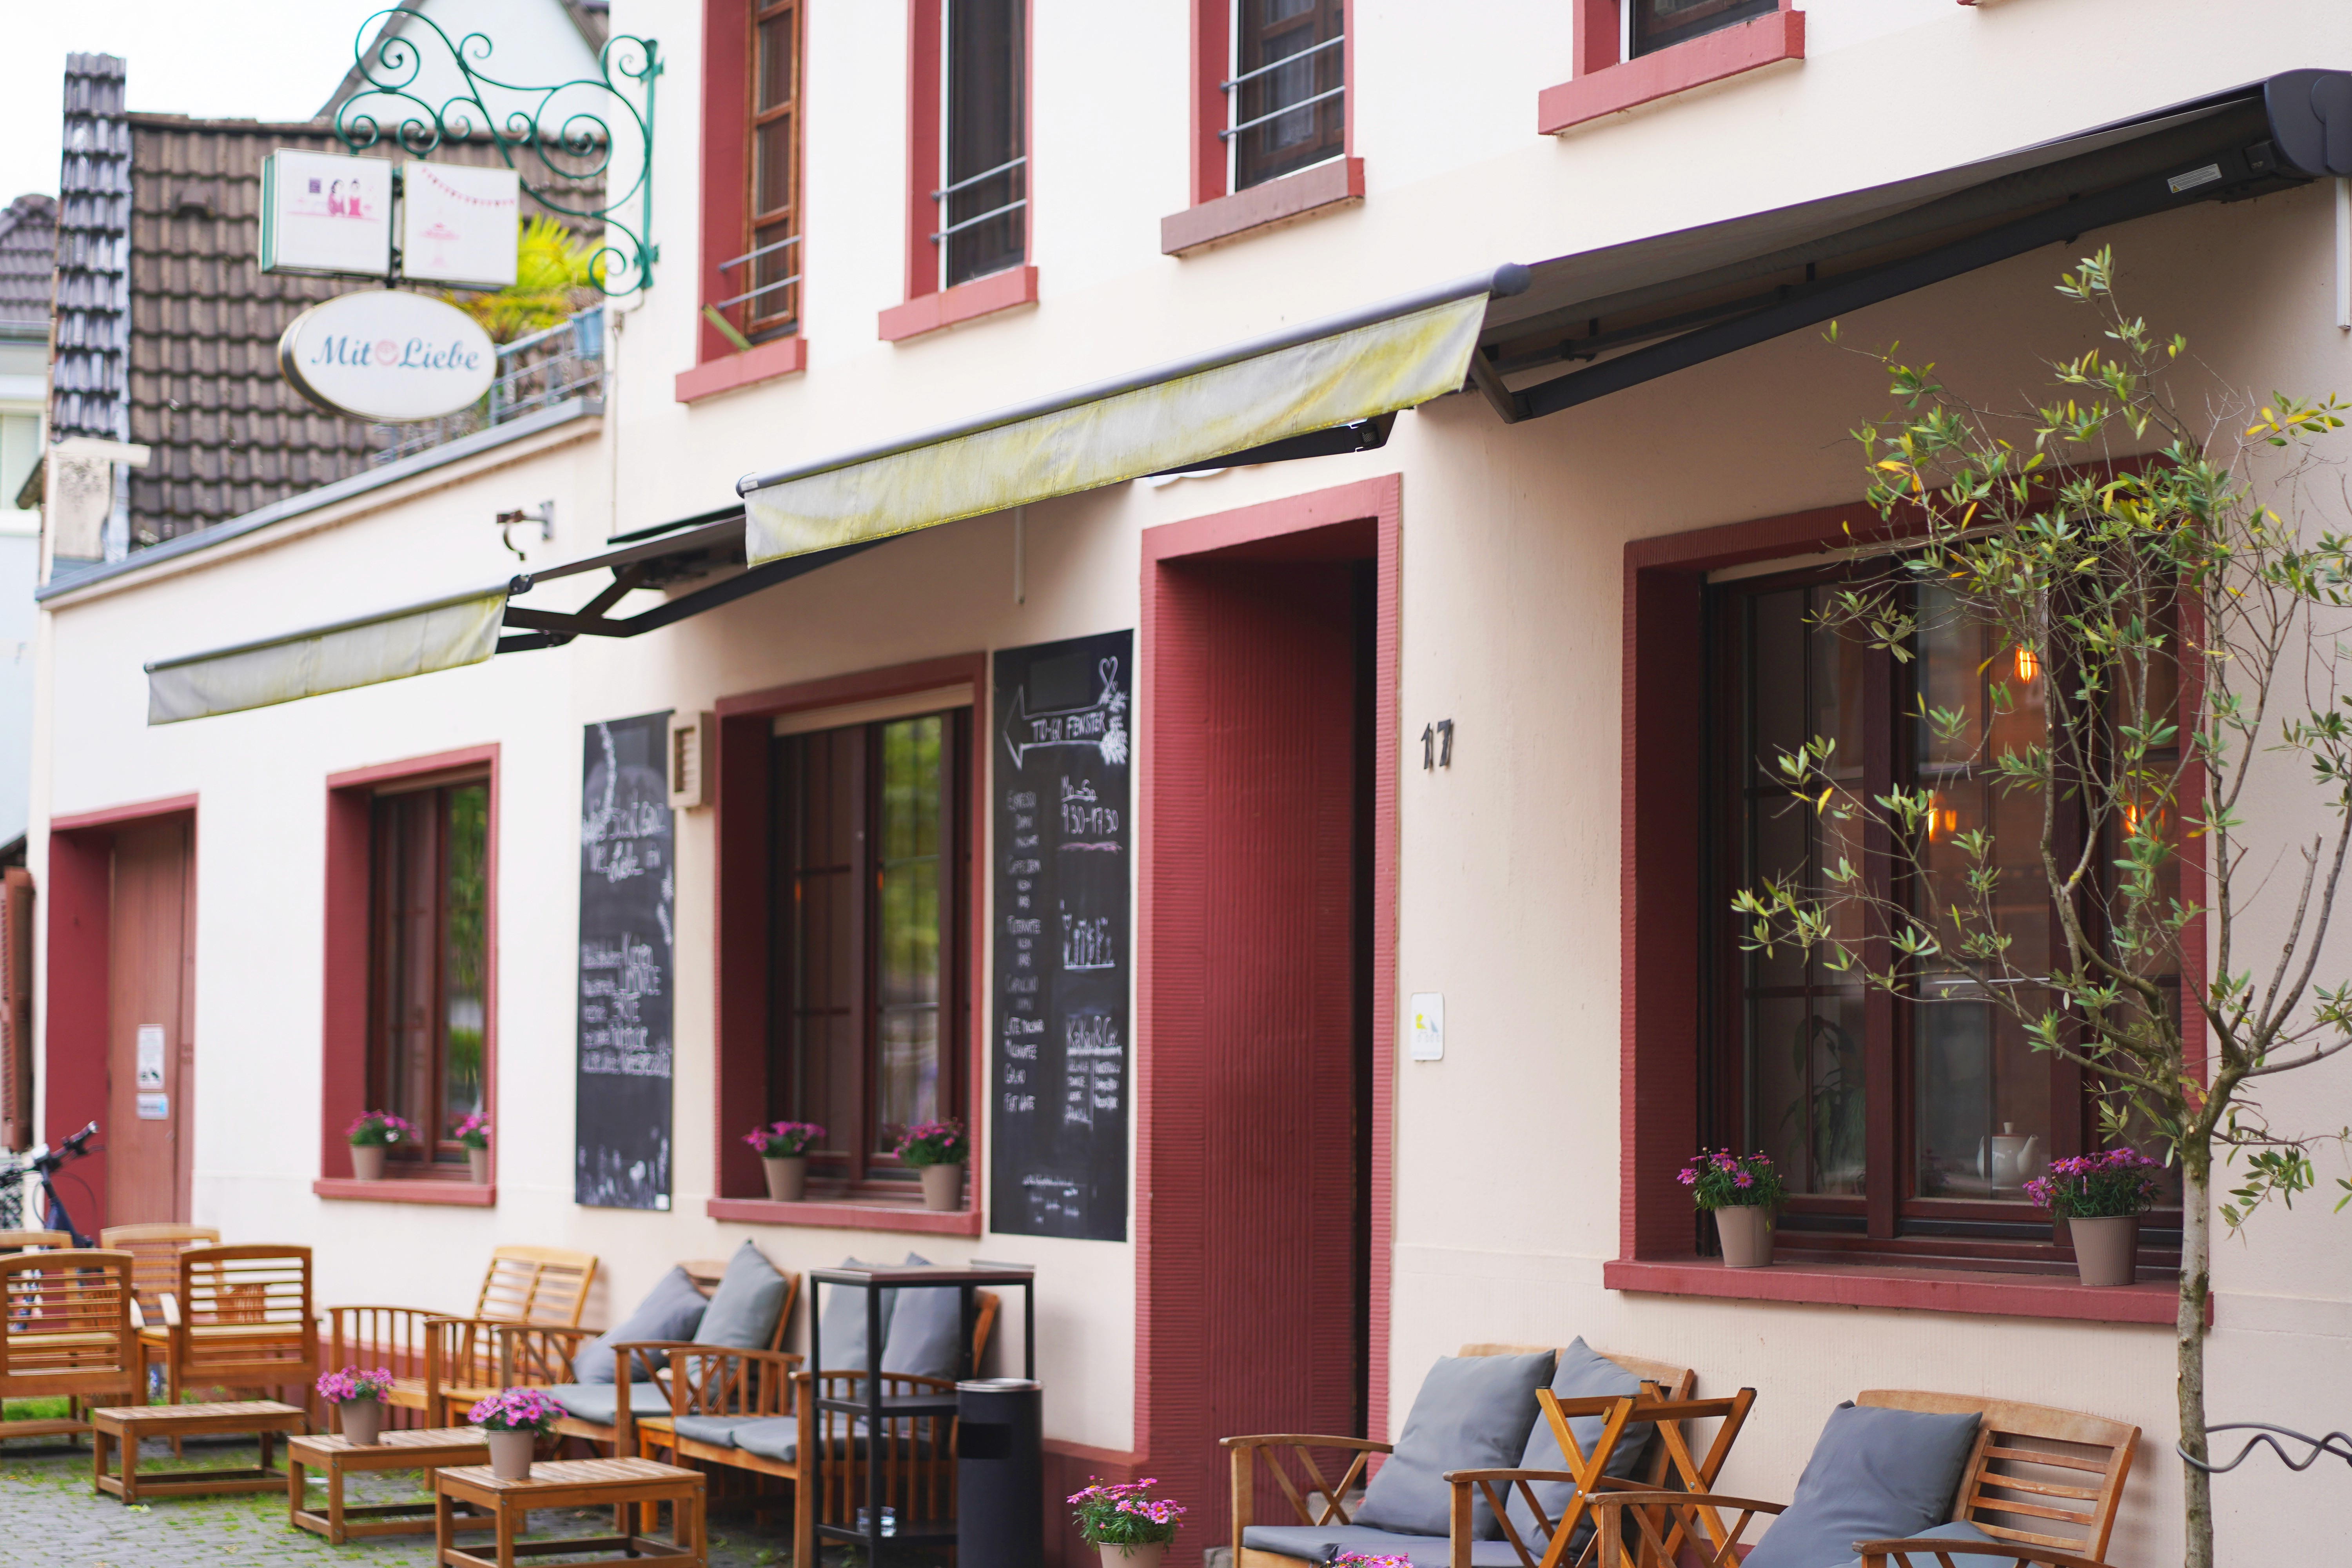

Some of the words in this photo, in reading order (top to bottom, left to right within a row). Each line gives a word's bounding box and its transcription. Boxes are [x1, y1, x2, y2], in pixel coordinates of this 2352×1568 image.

[311, 334, 372, 367] Mit
[399, 337, 480, 371] Liebe
[1031, 718, 1063, 742] TO-GO
[1065, 711, 1107, 740] FENSTER
[1421, 719, 1452, 769] 17
